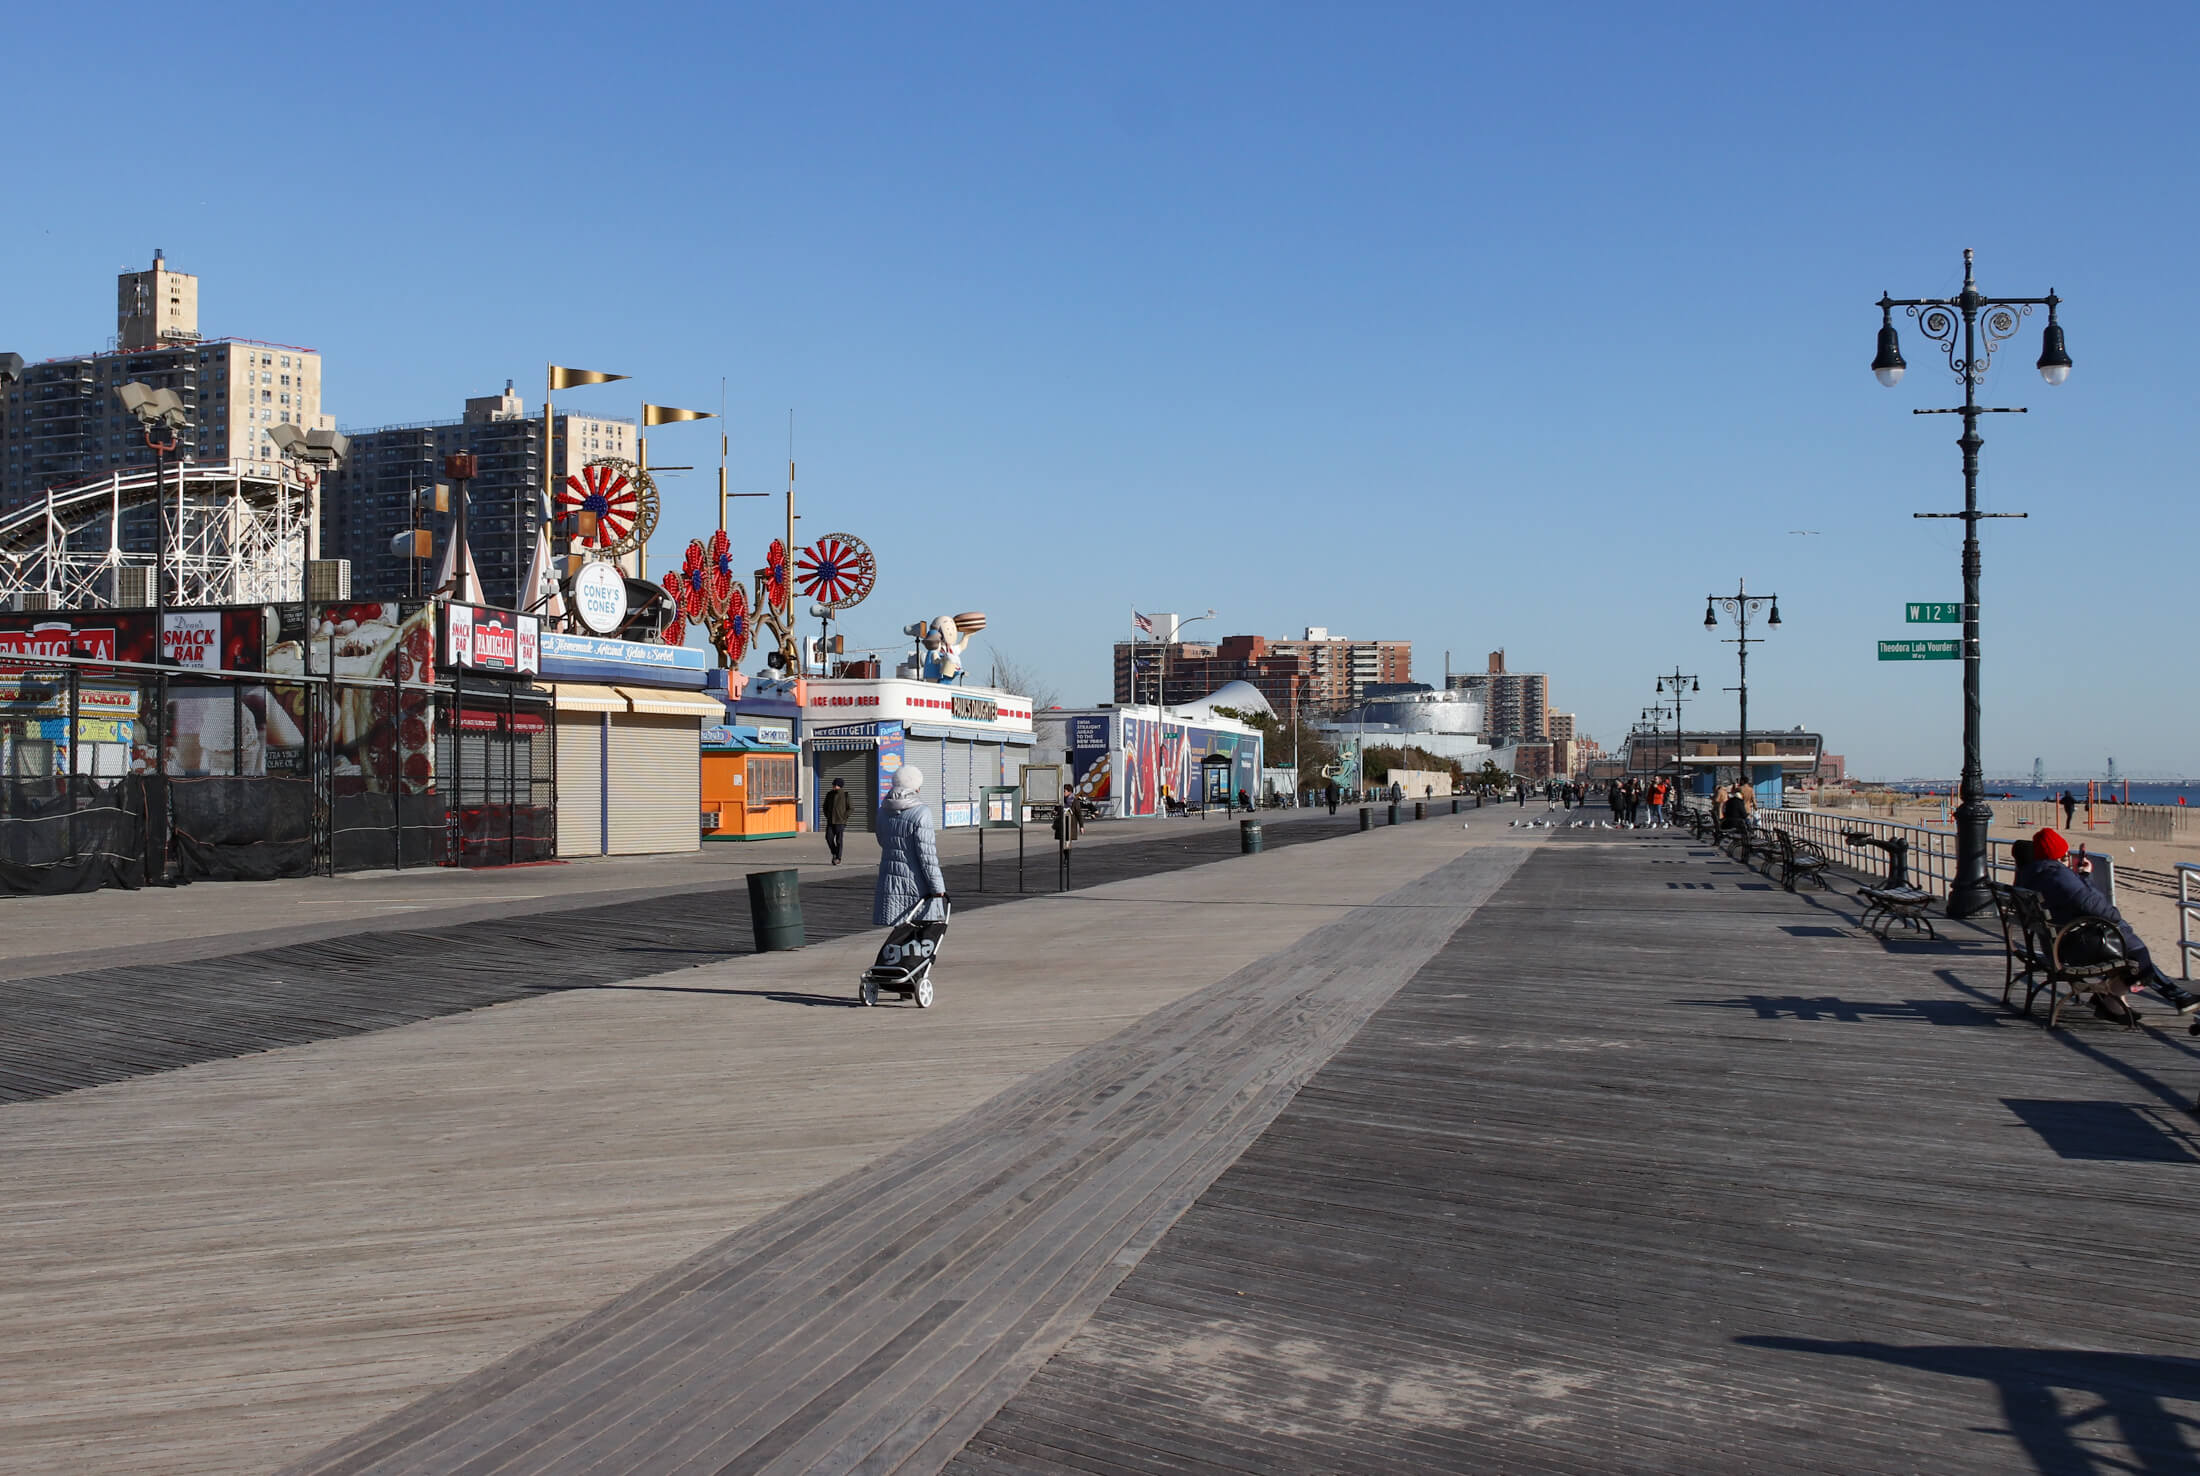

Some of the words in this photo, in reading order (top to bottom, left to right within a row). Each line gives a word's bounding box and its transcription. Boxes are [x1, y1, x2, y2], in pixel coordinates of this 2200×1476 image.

[584, 584, 620, 600] CONEY'S
[588, 600, 616, 614] CONES
[1910, 606, 1920, 620] W
[1926, 605, 1941, 620] 12
[1947, 605, 1956, 614] St
[163, 629, 216, 645] SNACK
[452, 623, 470, 638] SNACK
[455, 637, 466, 652] BAR
[476, 634, 512, 658] FAMIGLIA
[520, 633, 535, 646] SNACK
[1880, 643, 1909, 652] Theodora
[1912, 642, 1925, 652] Lula
[173, 645, 205, 661] BAR
[523, 646, 533, 660] BAR
[553, 638, 594, 654] Homemade
[625, 646, 645, 661] Gelato
[811, 696, 828, 706] ICE
[831, 696, 853, 706] COLD
[857, 695, 880, 706] BEER
[828, 728, 841, 736] GET
[841, 727, 848, 736] IT
[849, 725, 865, 735] GET
[866, 724, 876, 735] IT
